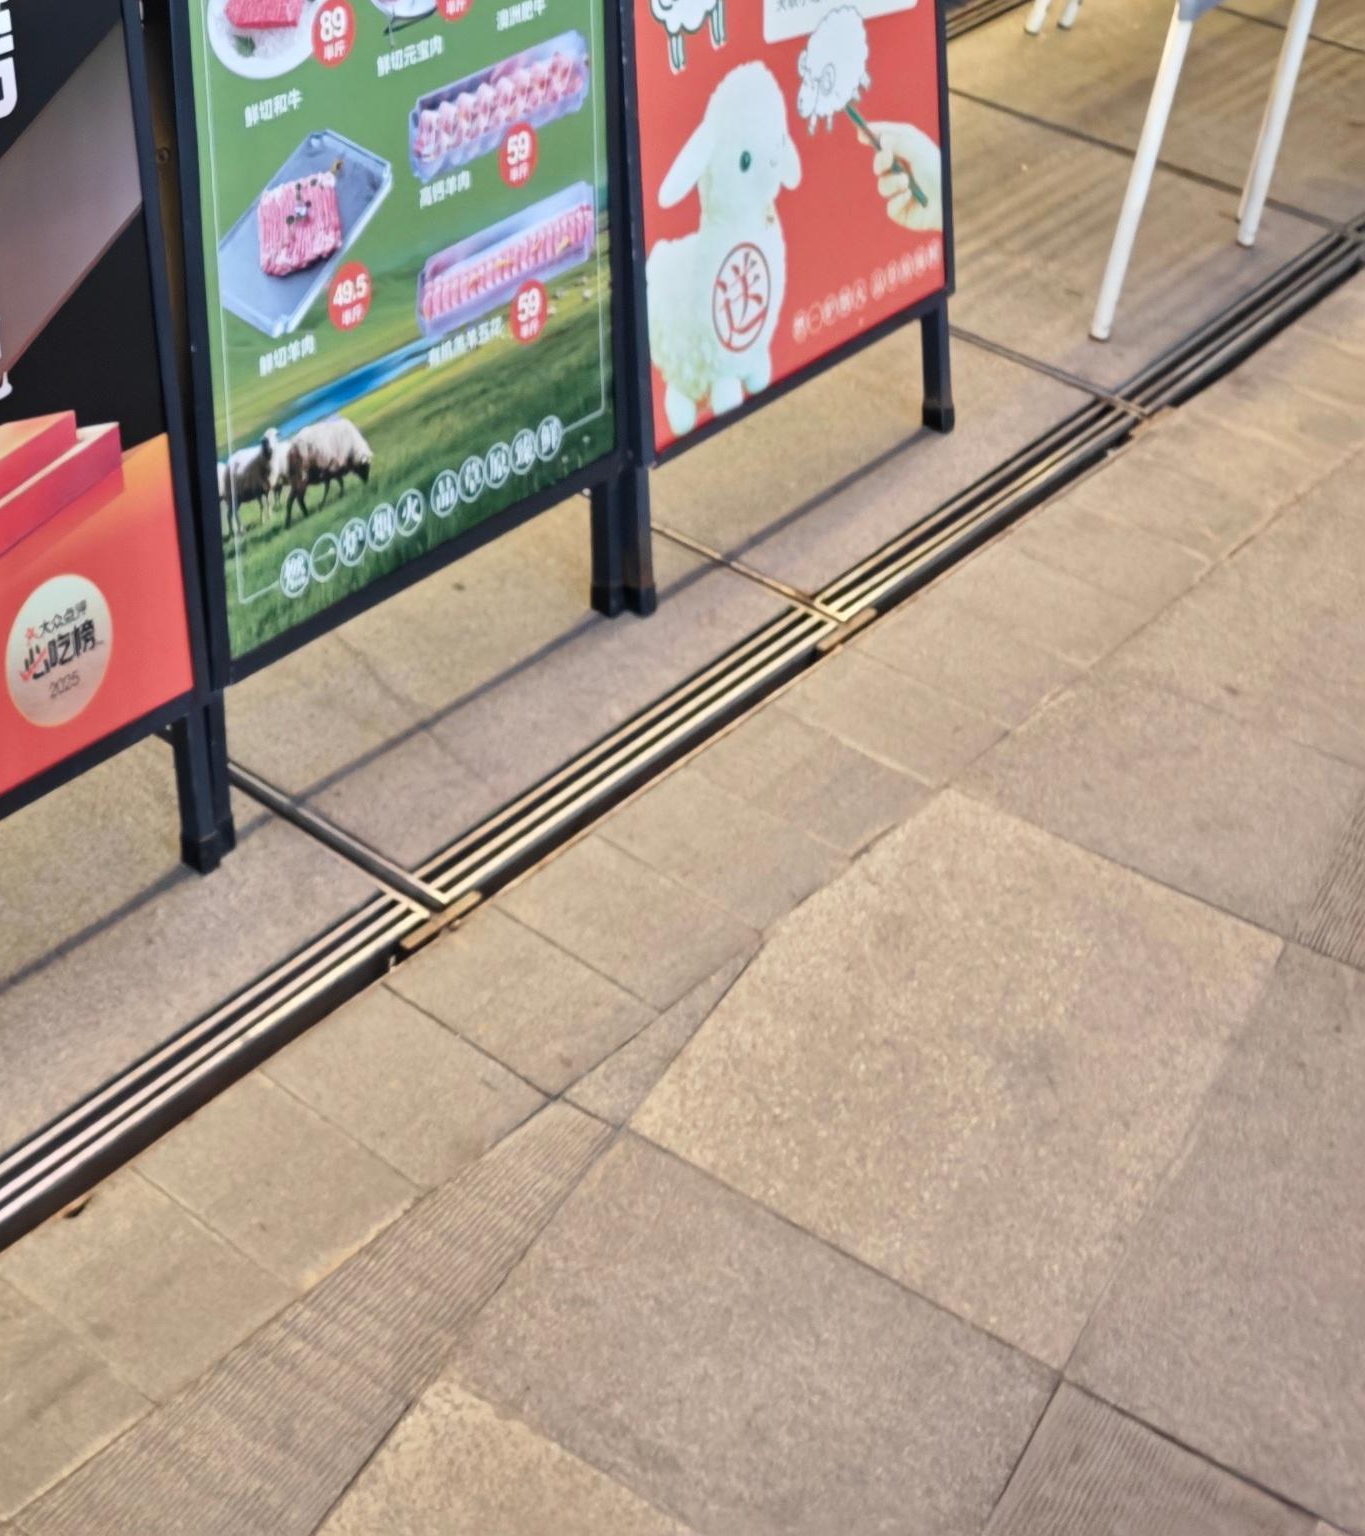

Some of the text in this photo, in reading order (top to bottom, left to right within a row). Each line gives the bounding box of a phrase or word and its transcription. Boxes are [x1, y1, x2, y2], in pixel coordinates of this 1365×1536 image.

[319, 6, 348, 43] 89
[506, 130, 531, 166] 59
[333, 272, 370, 308] 49.5
[517, 287, 541, 322] 59
[716, 251, 767, 335] 送
[39, 600, 87, 634] 大众点评
[20, 619, 96, 682] 必吃榜
[48, 671, 80, 699] 2025
